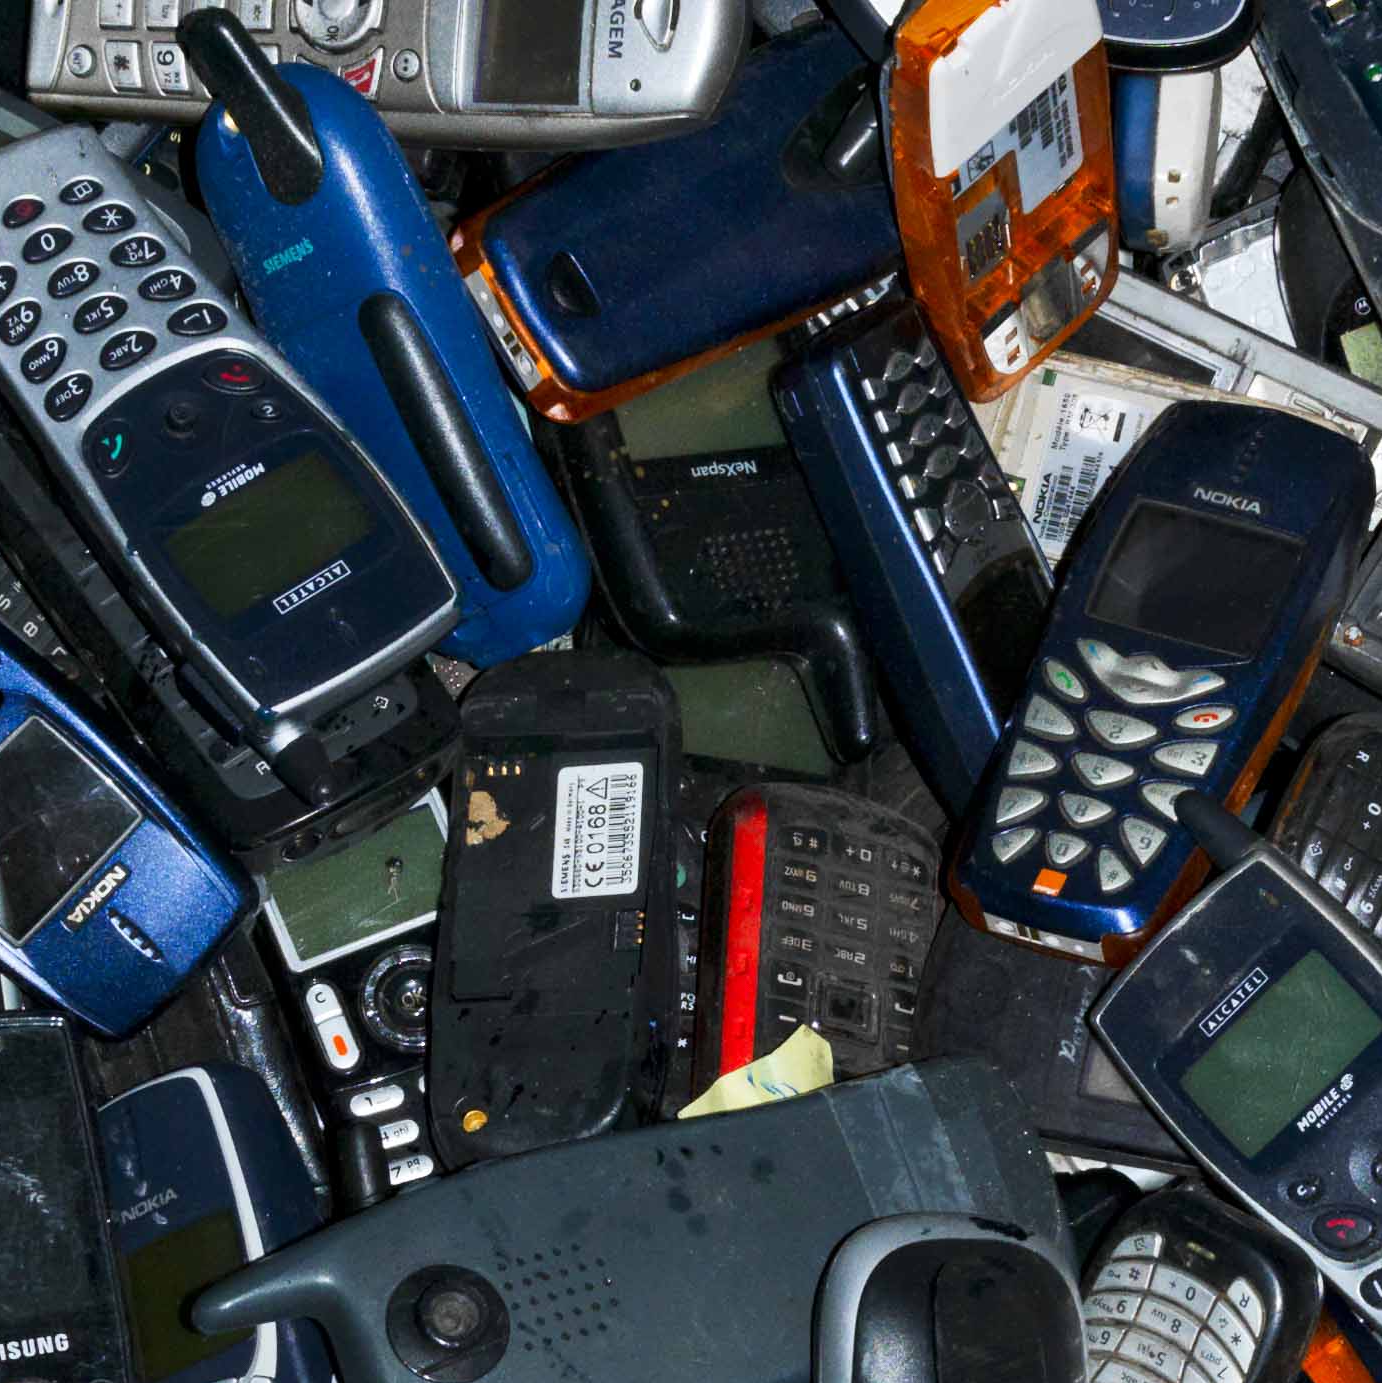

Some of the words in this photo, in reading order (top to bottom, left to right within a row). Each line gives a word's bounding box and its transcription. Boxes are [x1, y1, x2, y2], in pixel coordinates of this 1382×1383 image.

[607, 0, 624, 60] AGEM
[262, 237, 314, 276] SIEMENS
[216, 461, 266, 498] MOBILE
[690, 458, 758, 479] NeXspan
[1027, 470, 1056, 524] NOKIA
[1193, 485, 1262, 515] NOKIA
[278, 562, 346, 612] ALCATEL
[584, 803, 607, 854] 0168
[64, 864, 126, 926] NOKIA
[314, 991, 327, 1005] C
[1203, 973, 1266, 1034] ALCATEL
[1296, 1084, 1343, 1133] MOBILE
[120, 1187, 179, 1225] NOKIA
